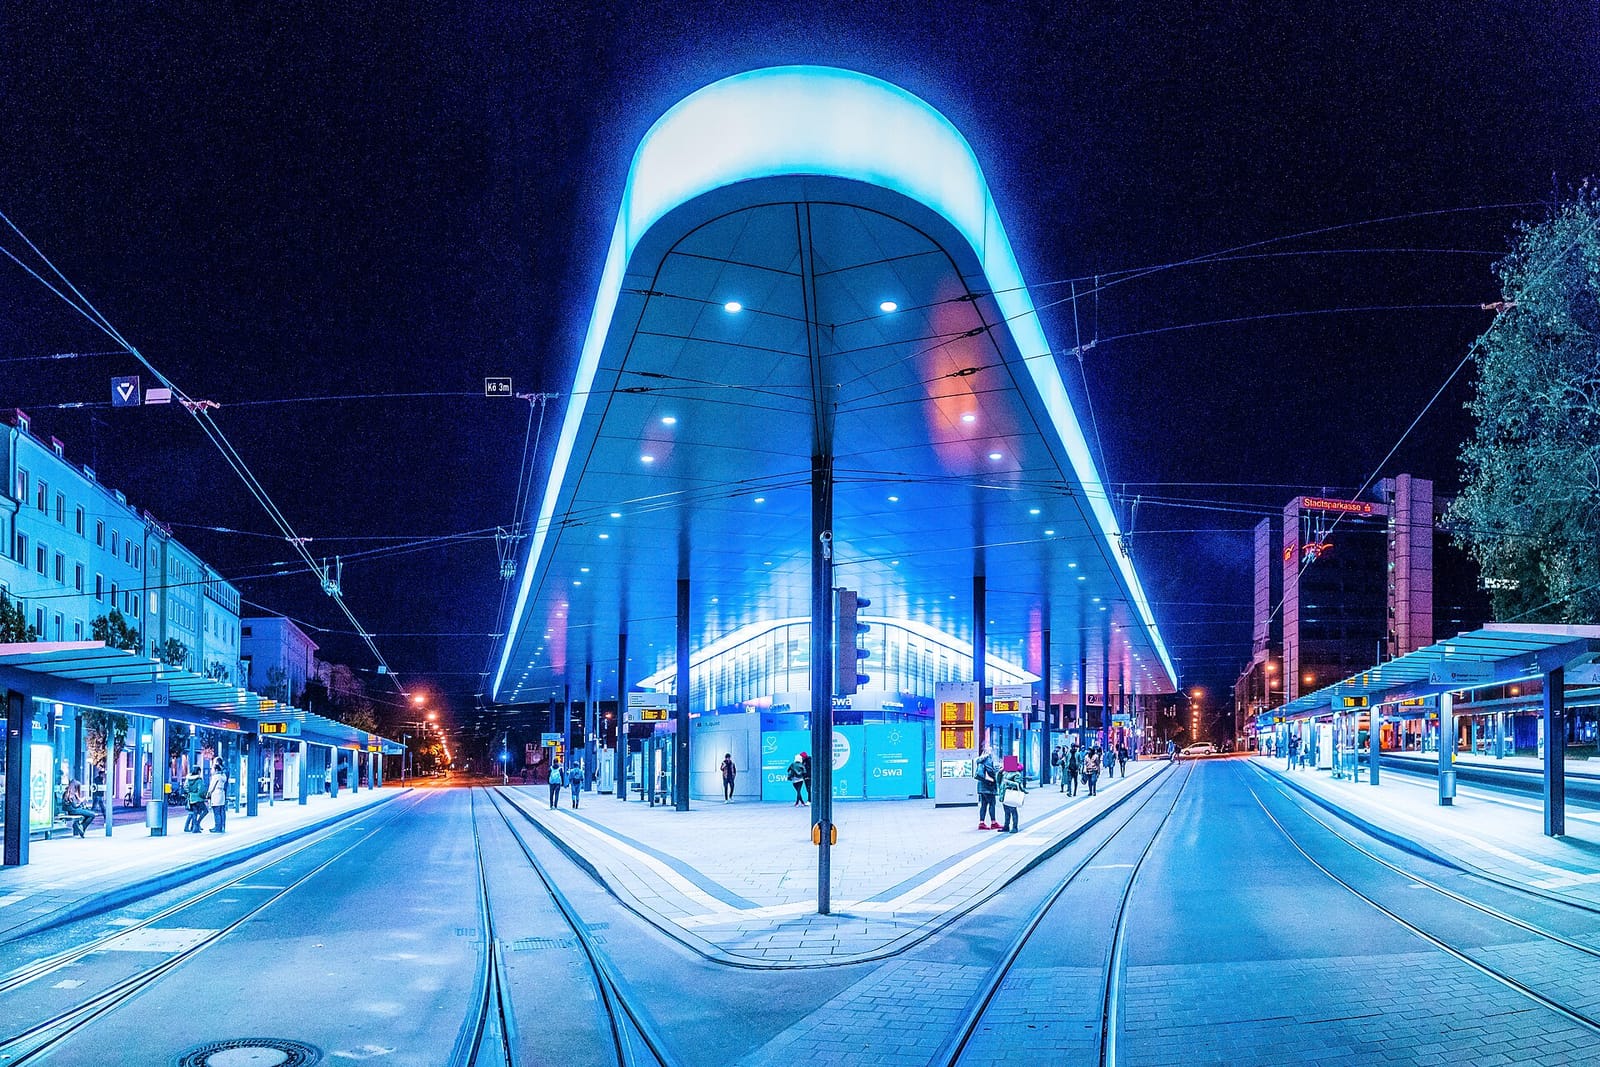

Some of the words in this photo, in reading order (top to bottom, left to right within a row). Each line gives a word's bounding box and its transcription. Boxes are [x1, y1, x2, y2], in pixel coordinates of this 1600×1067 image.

[1304, 498, 1361, 511] Stadtsparkasse
[1431, 672, 1441, 682] A2
[156, 694, 168, 704] B2
[832, 697, 852, 706] swa
[882, 768, 903, 777] swa
[775, 774, 789, 783] sw
